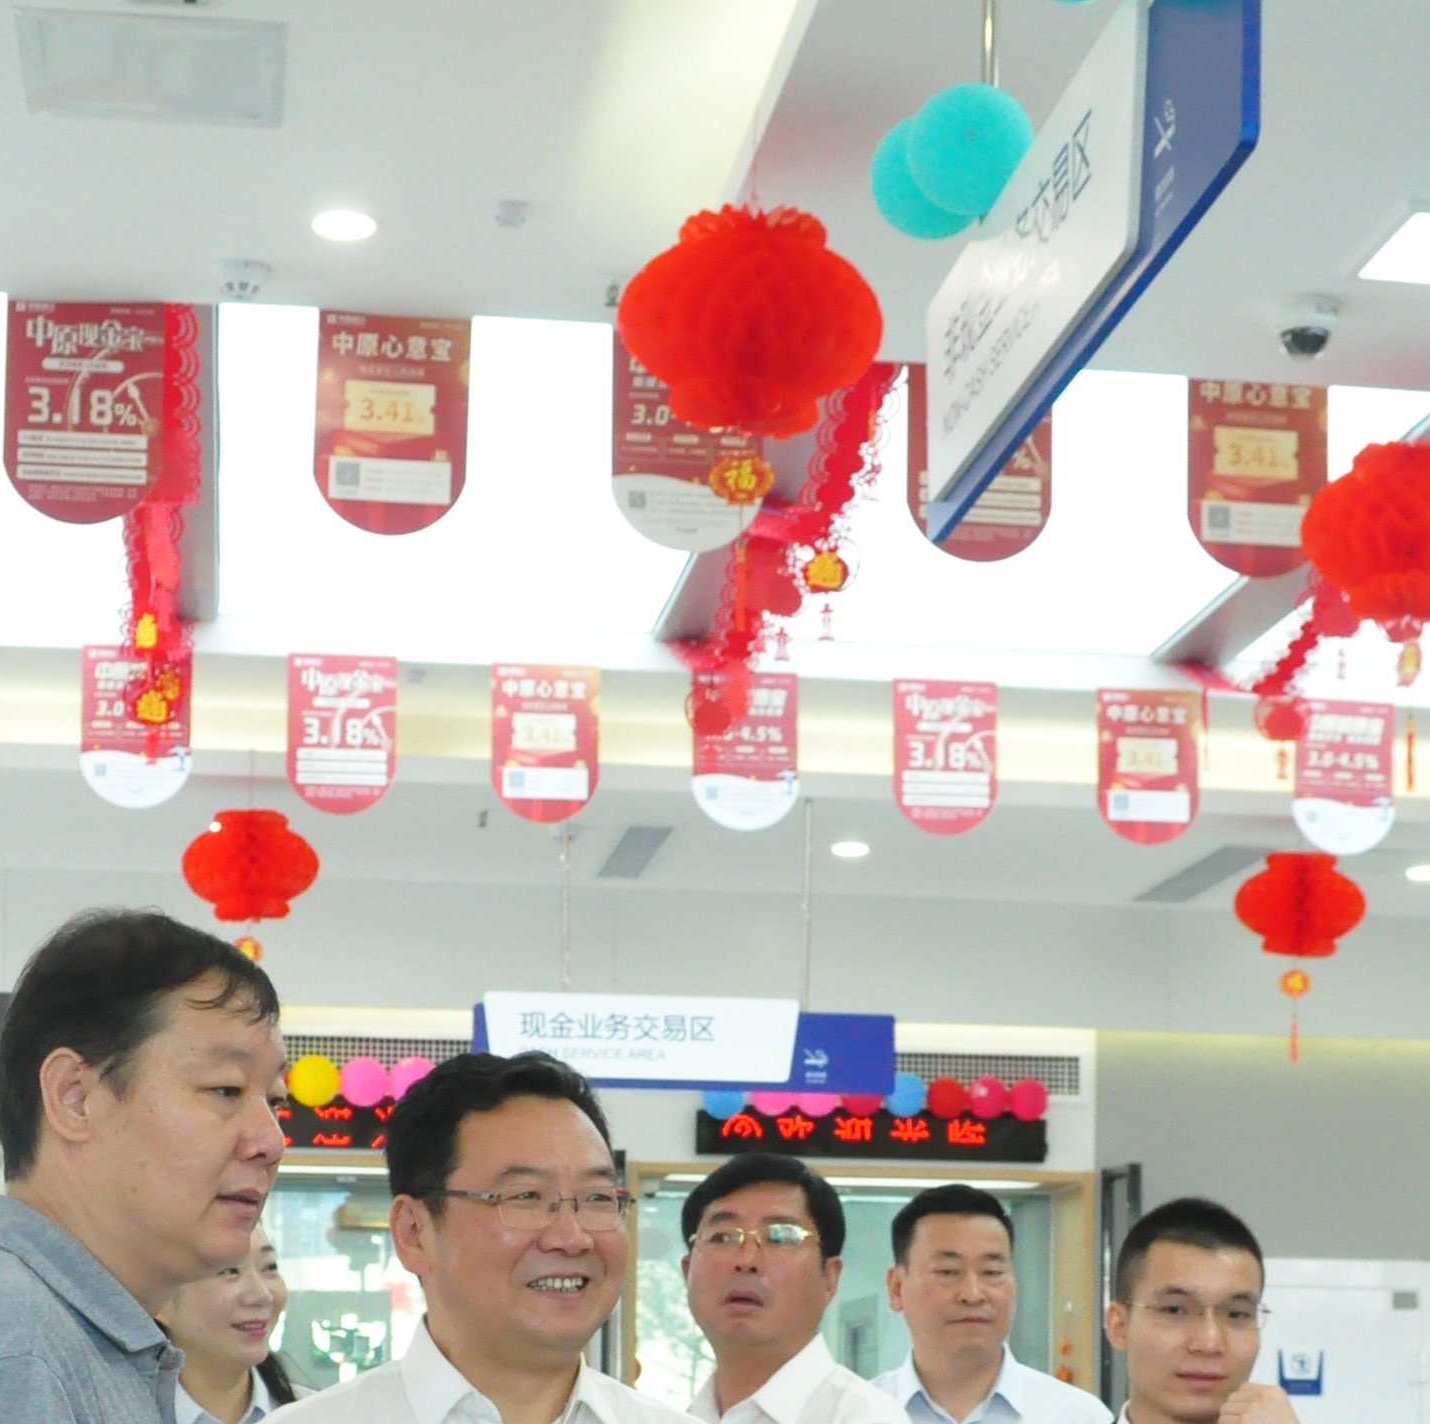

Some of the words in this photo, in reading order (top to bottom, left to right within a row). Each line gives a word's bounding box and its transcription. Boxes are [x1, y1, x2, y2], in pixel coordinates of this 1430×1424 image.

[519, 1011, 716, 1042] 现金业务交易区
[628, 1048, 667, 1060] AREA
